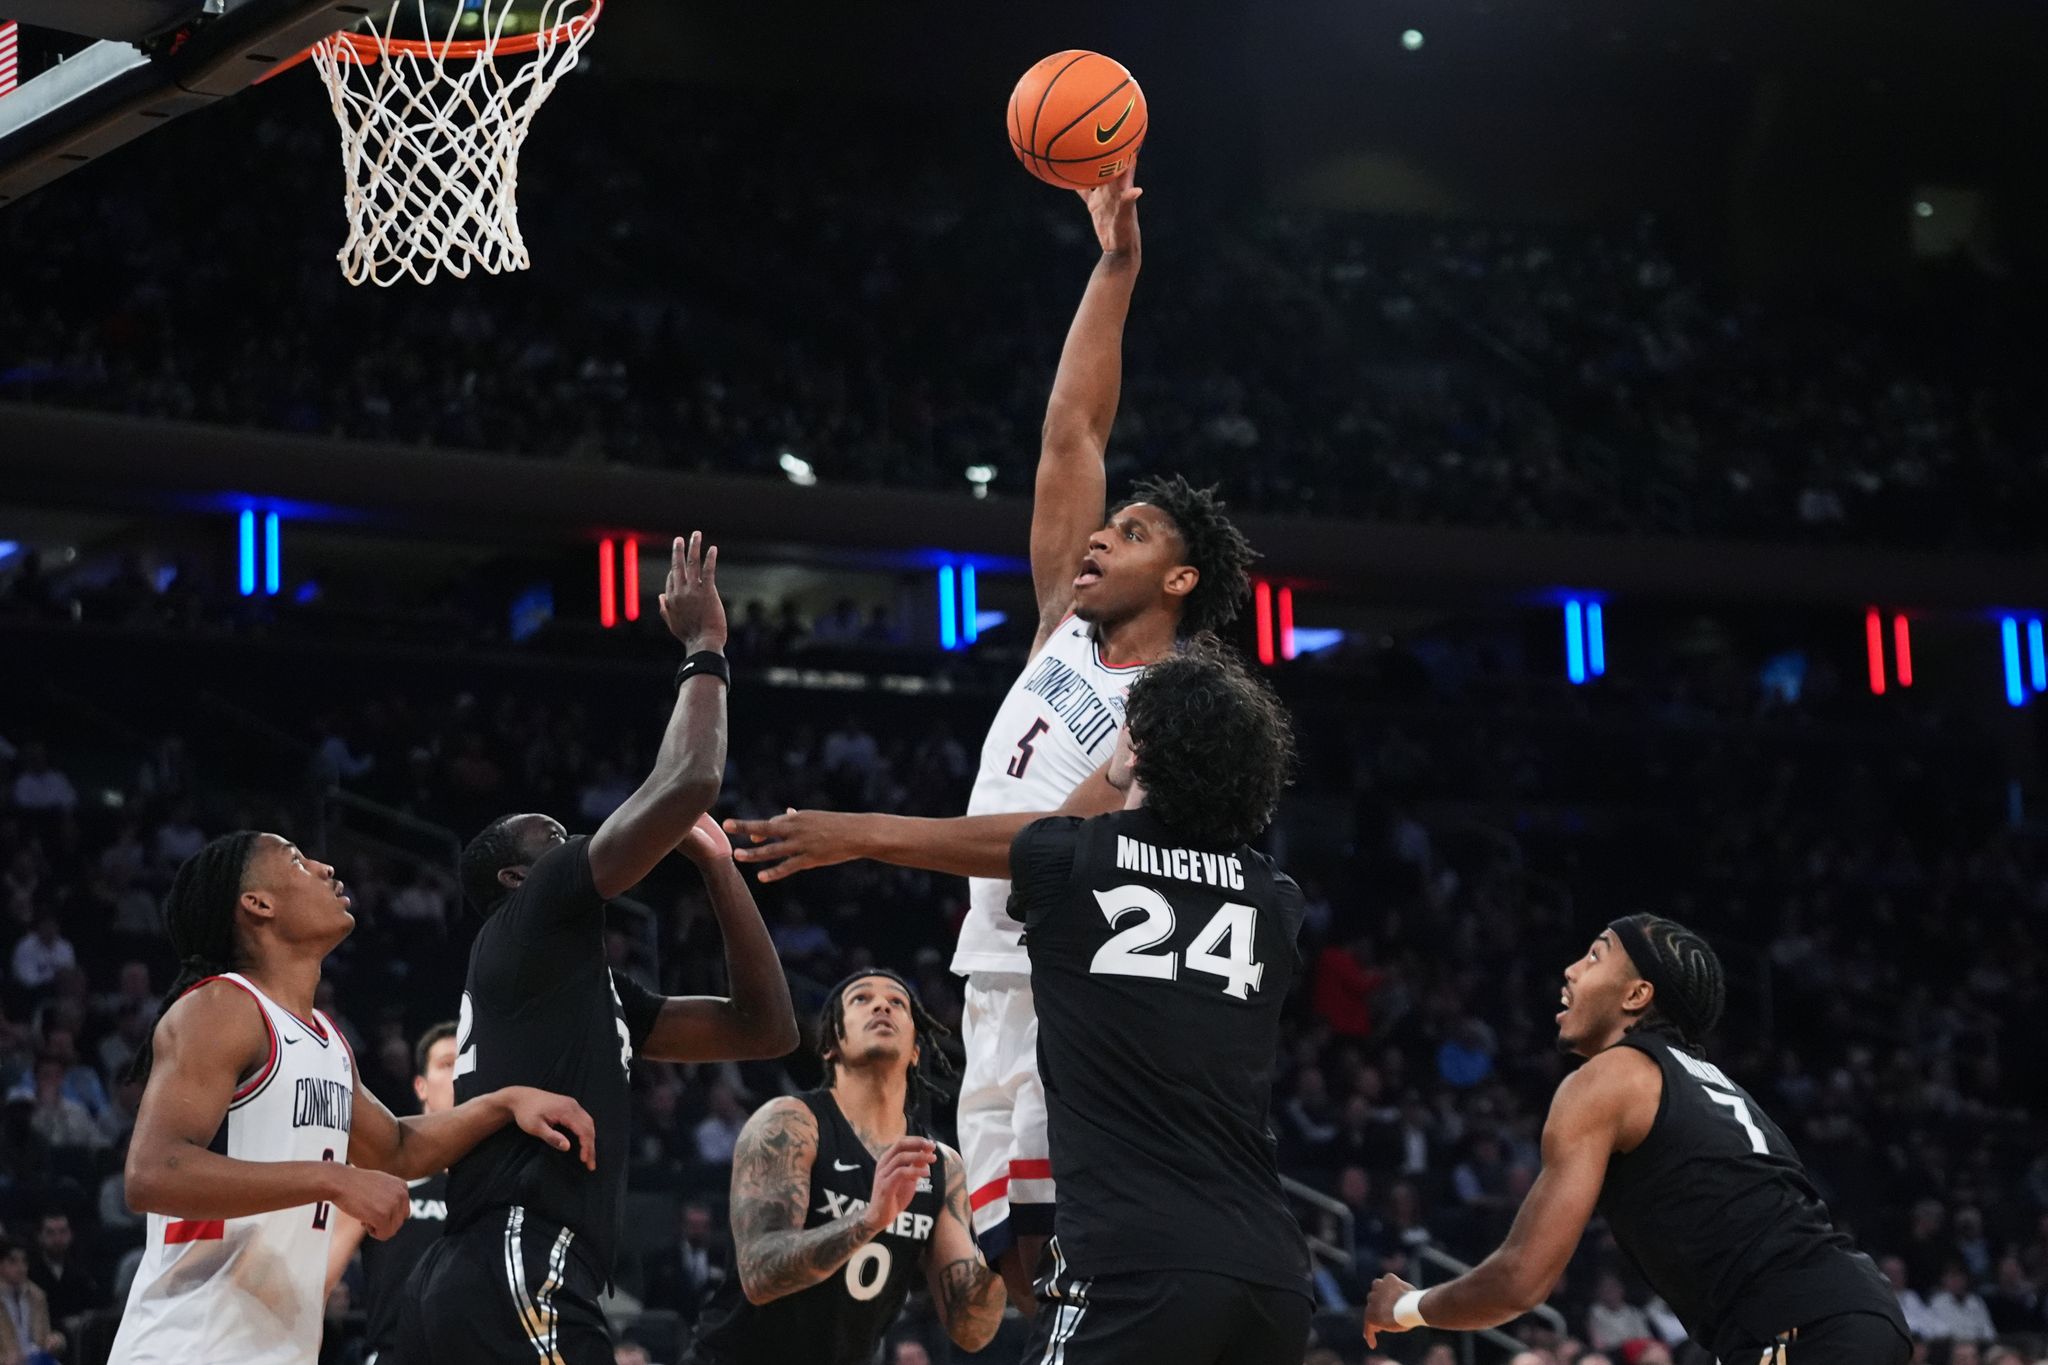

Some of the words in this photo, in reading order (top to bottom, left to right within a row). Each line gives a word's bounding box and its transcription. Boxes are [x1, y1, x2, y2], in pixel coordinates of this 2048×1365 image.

[1023, 656, 1118, 756] CONNECTICUT
[1006, 717, 1050, 780] 5
[1089, 884, 1264, 1000] 24
[845, 1242, 892, 1301] 0
